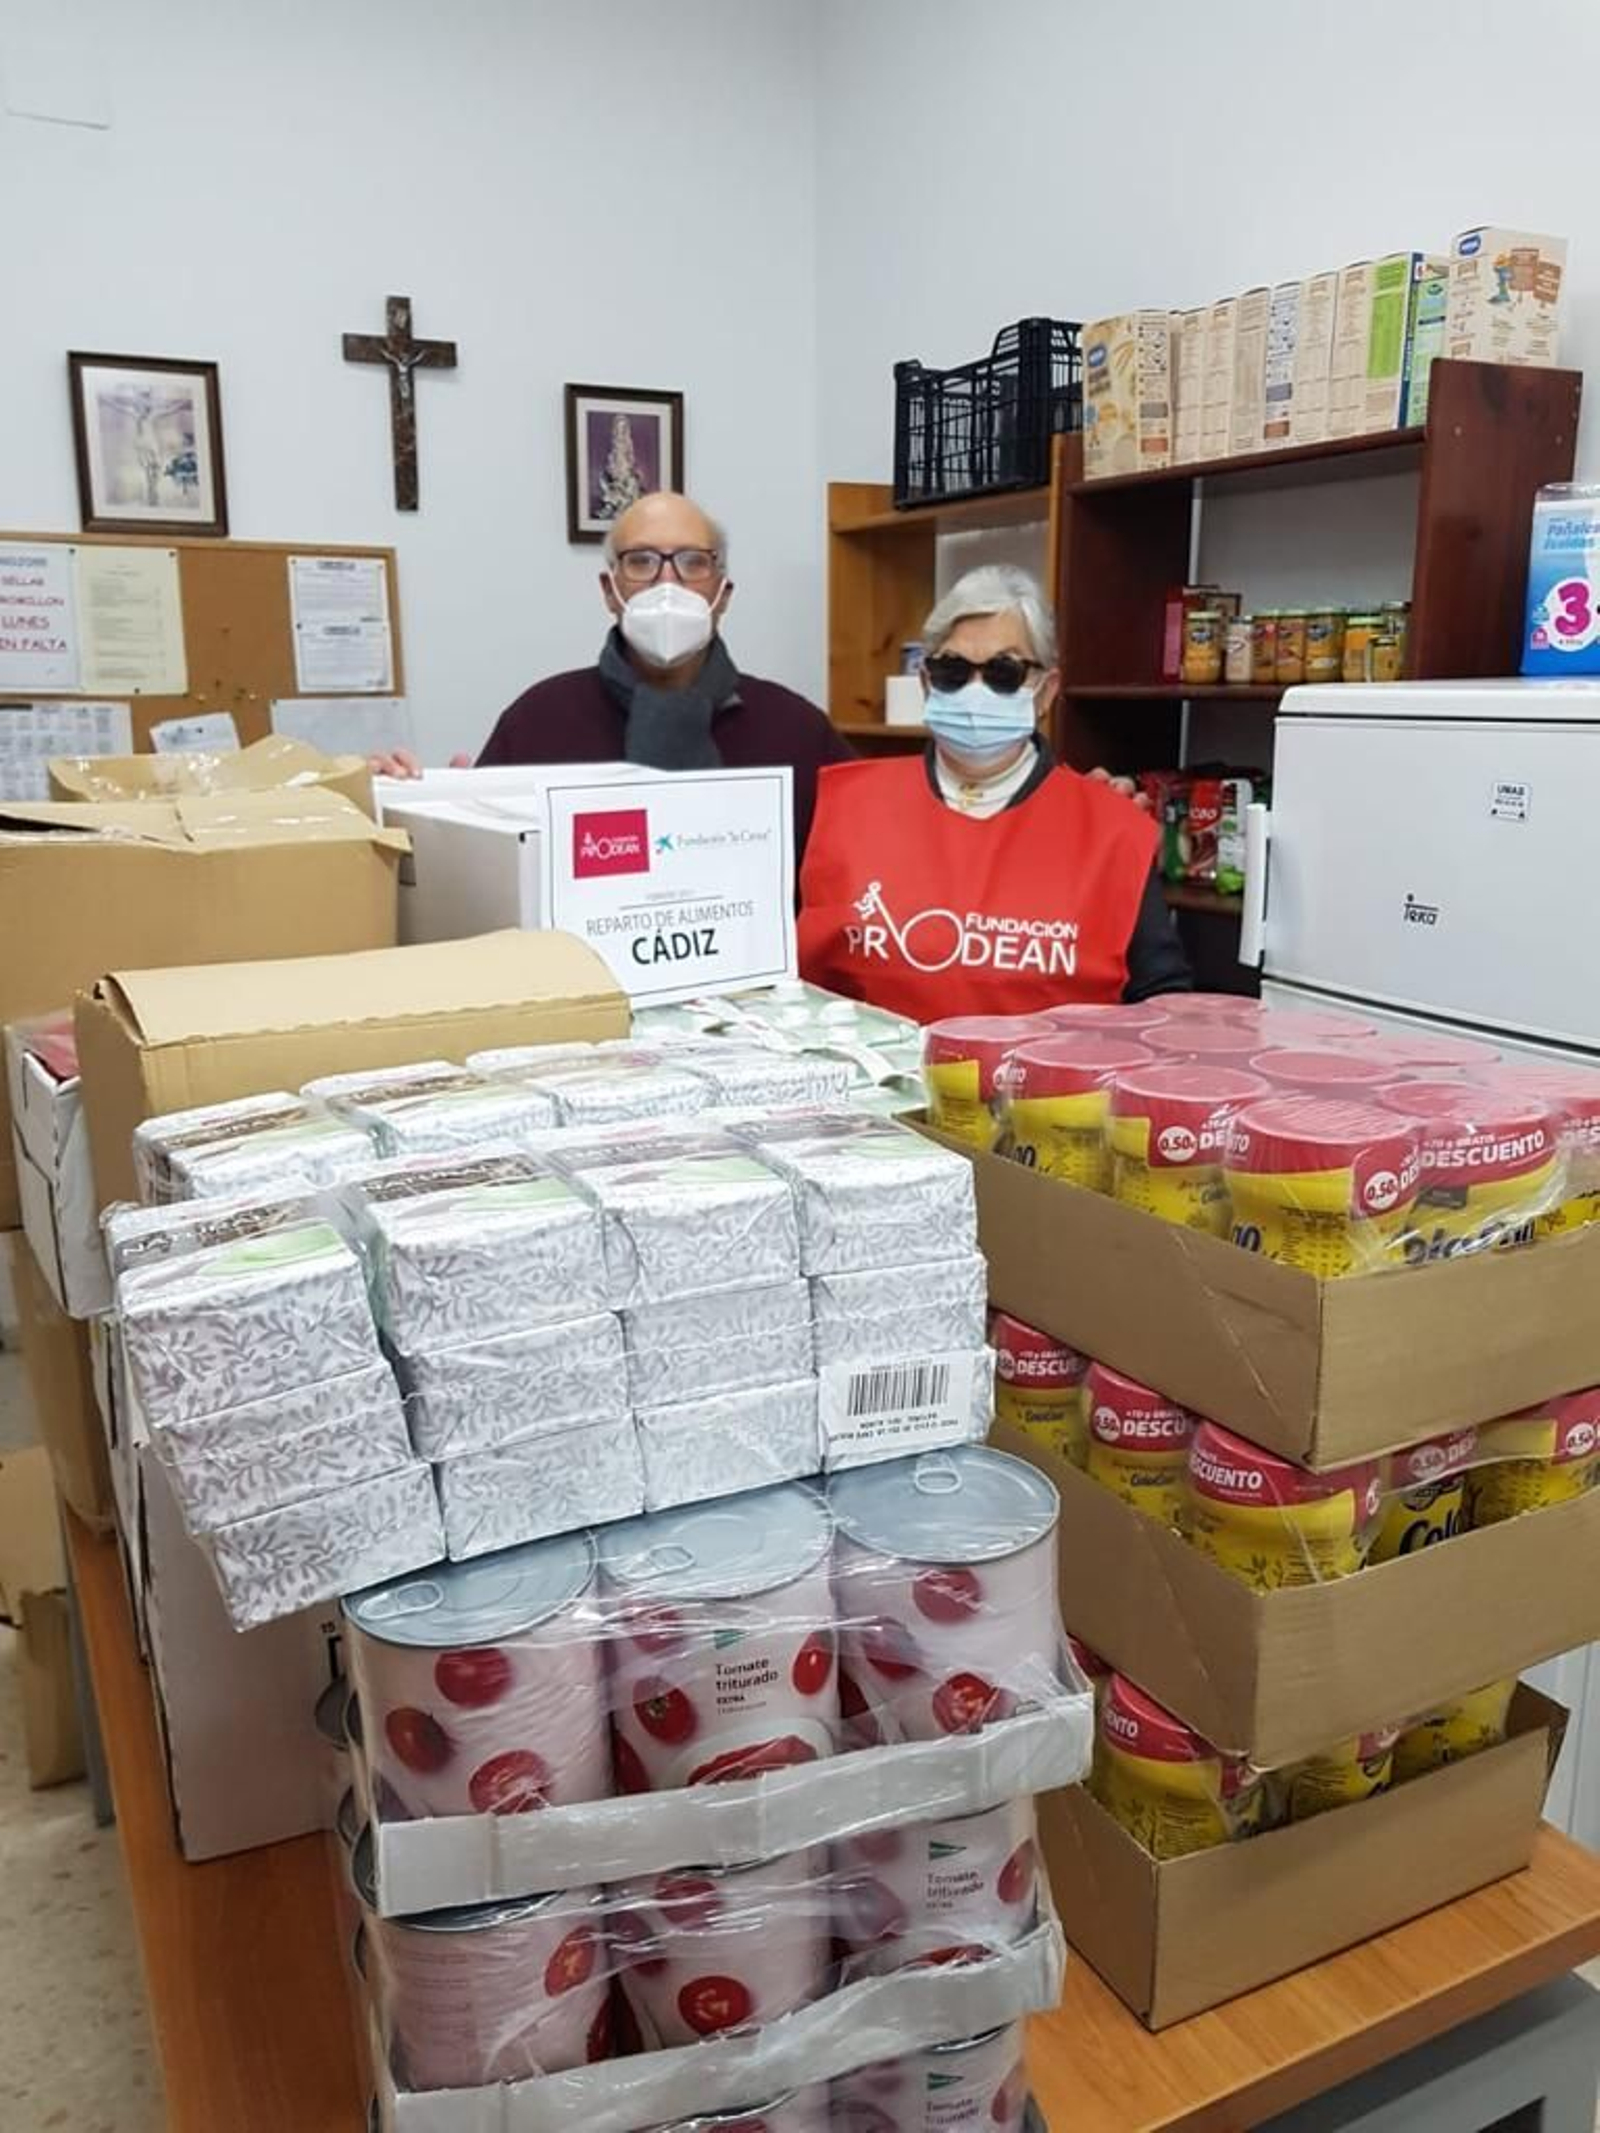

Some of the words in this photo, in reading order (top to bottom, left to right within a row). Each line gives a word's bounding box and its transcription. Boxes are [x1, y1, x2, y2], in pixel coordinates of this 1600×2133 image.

[1555, 582, 1591, 636] 3
[586, 912, 651, 937] REPARTO
[656, 909, 676, 929] DE
[678, 900, 755, 926] ALIMENTOS
[964, 912, 1078, 940] FUNDACIÓN
[631, 928, 719, 965] CÁDIZ
[1421, 1129, 1545, 1169] DESCUENTO
[715, 1657, 769, 1676] Tomate
[715, 1670, 779, 1692] triturado
